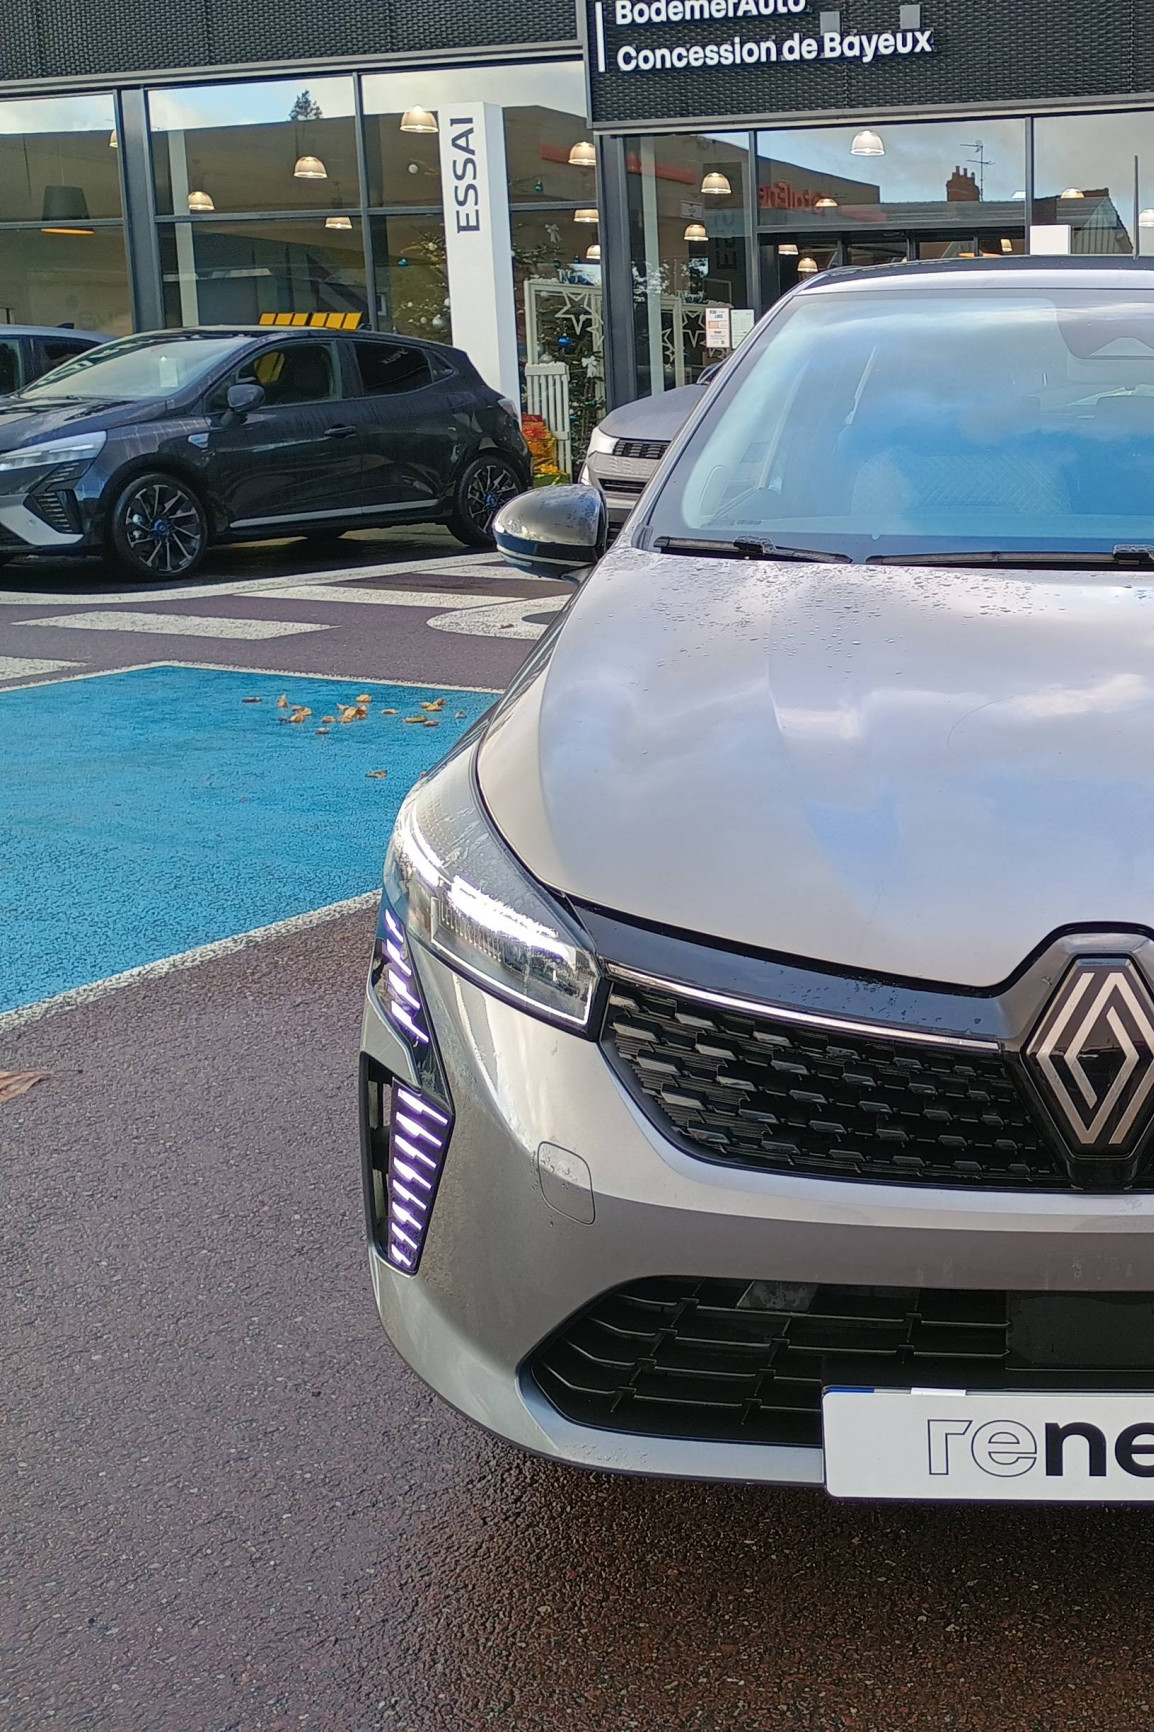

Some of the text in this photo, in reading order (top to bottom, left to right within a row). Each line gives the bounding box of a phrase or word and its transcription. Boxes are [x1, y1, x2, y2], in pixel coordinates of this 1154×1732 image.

[616, 0, 806, 25] BodemerAuto
[617, 30, 933, 72] Concession de Bayeux
[449, 117, 480, 234] ESSAI
